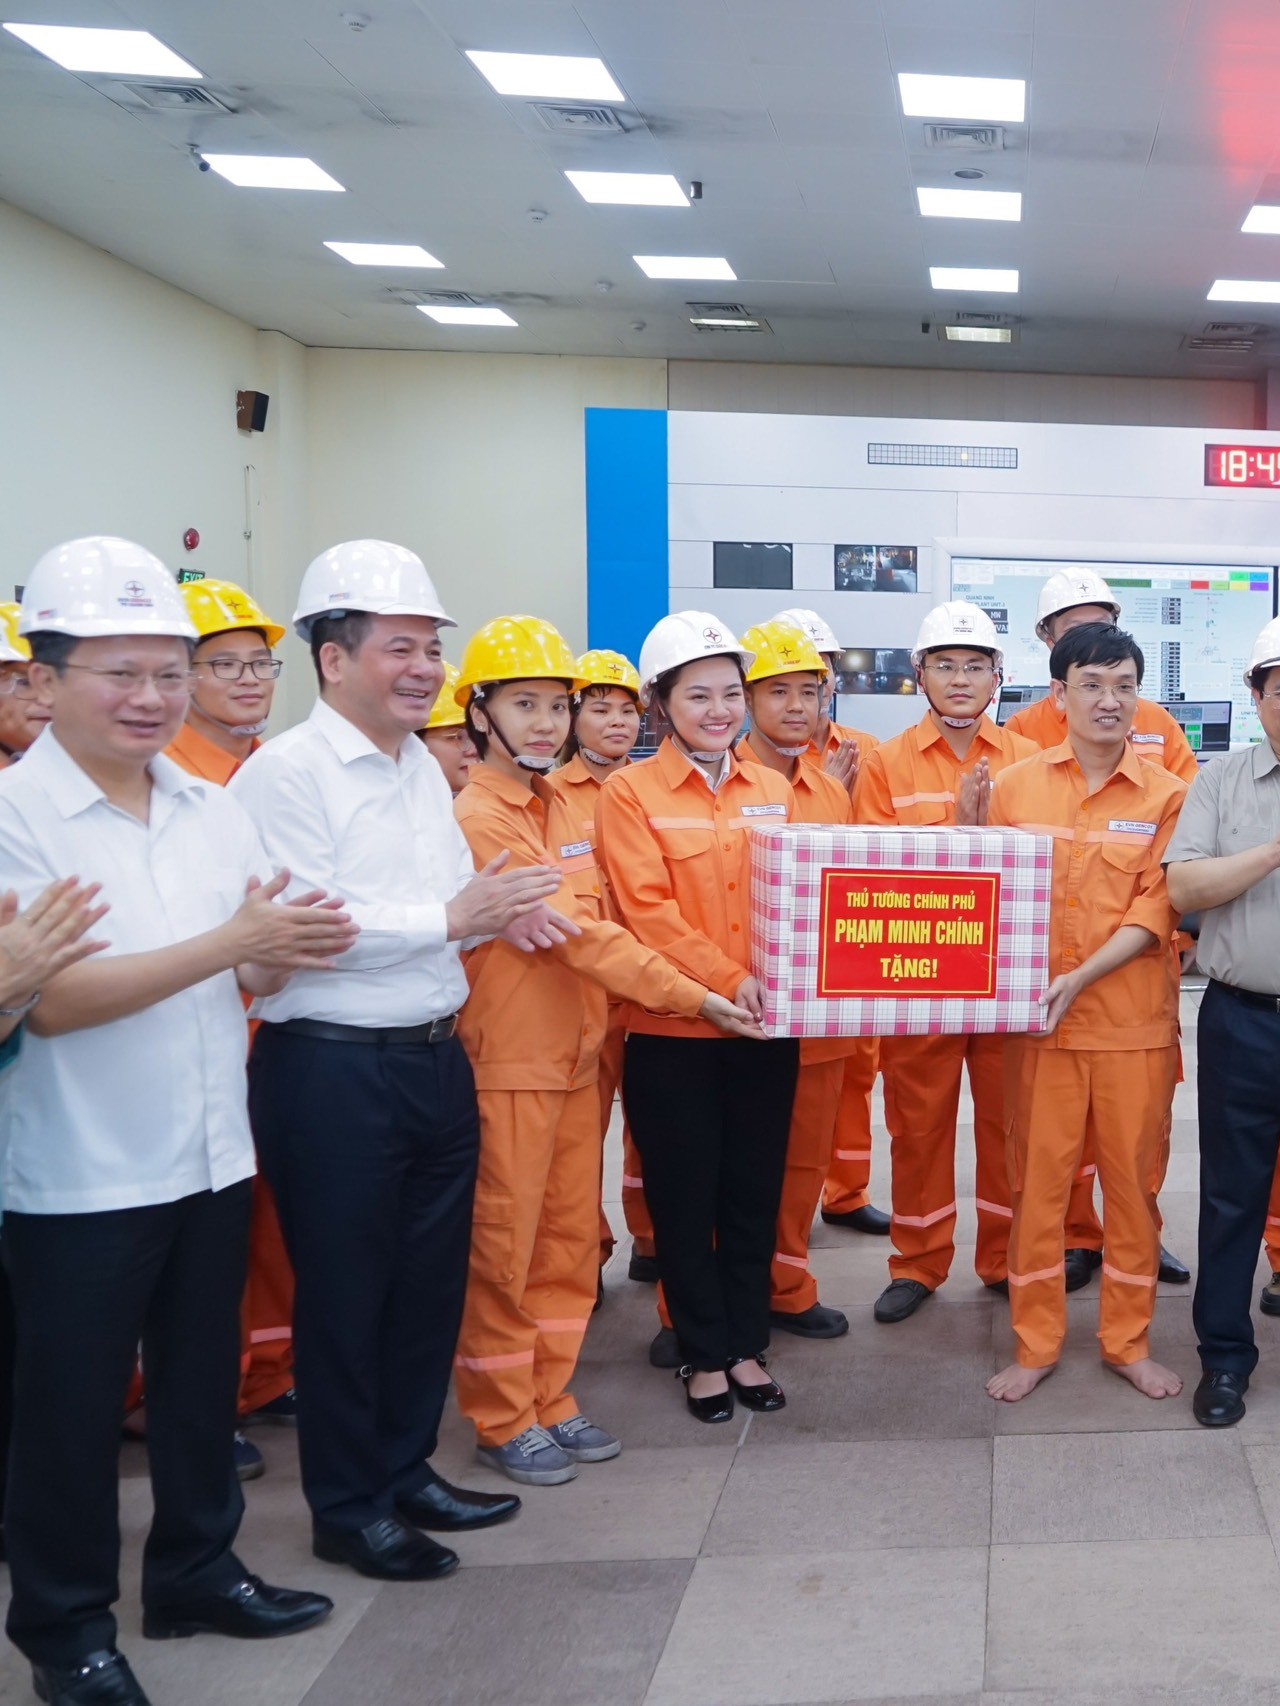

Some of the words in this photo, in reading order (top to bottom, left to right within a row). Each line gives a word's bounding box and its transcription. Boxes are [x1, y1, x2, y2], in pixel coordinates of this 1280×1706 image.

[846, 888, 868, 908] THỦ
[872, 890, 910, 908] TƯỚNG
[914, 891, 949, 909] CHÍNH
[952, 890, 976, 910] PHỦ
[835, 919, 883, 948] PHẠM
[888, 920, 931, 944] MINH
[935, 916, 984, 945] CHÍNH
[880, 954, 938, 982] TẶNG!
